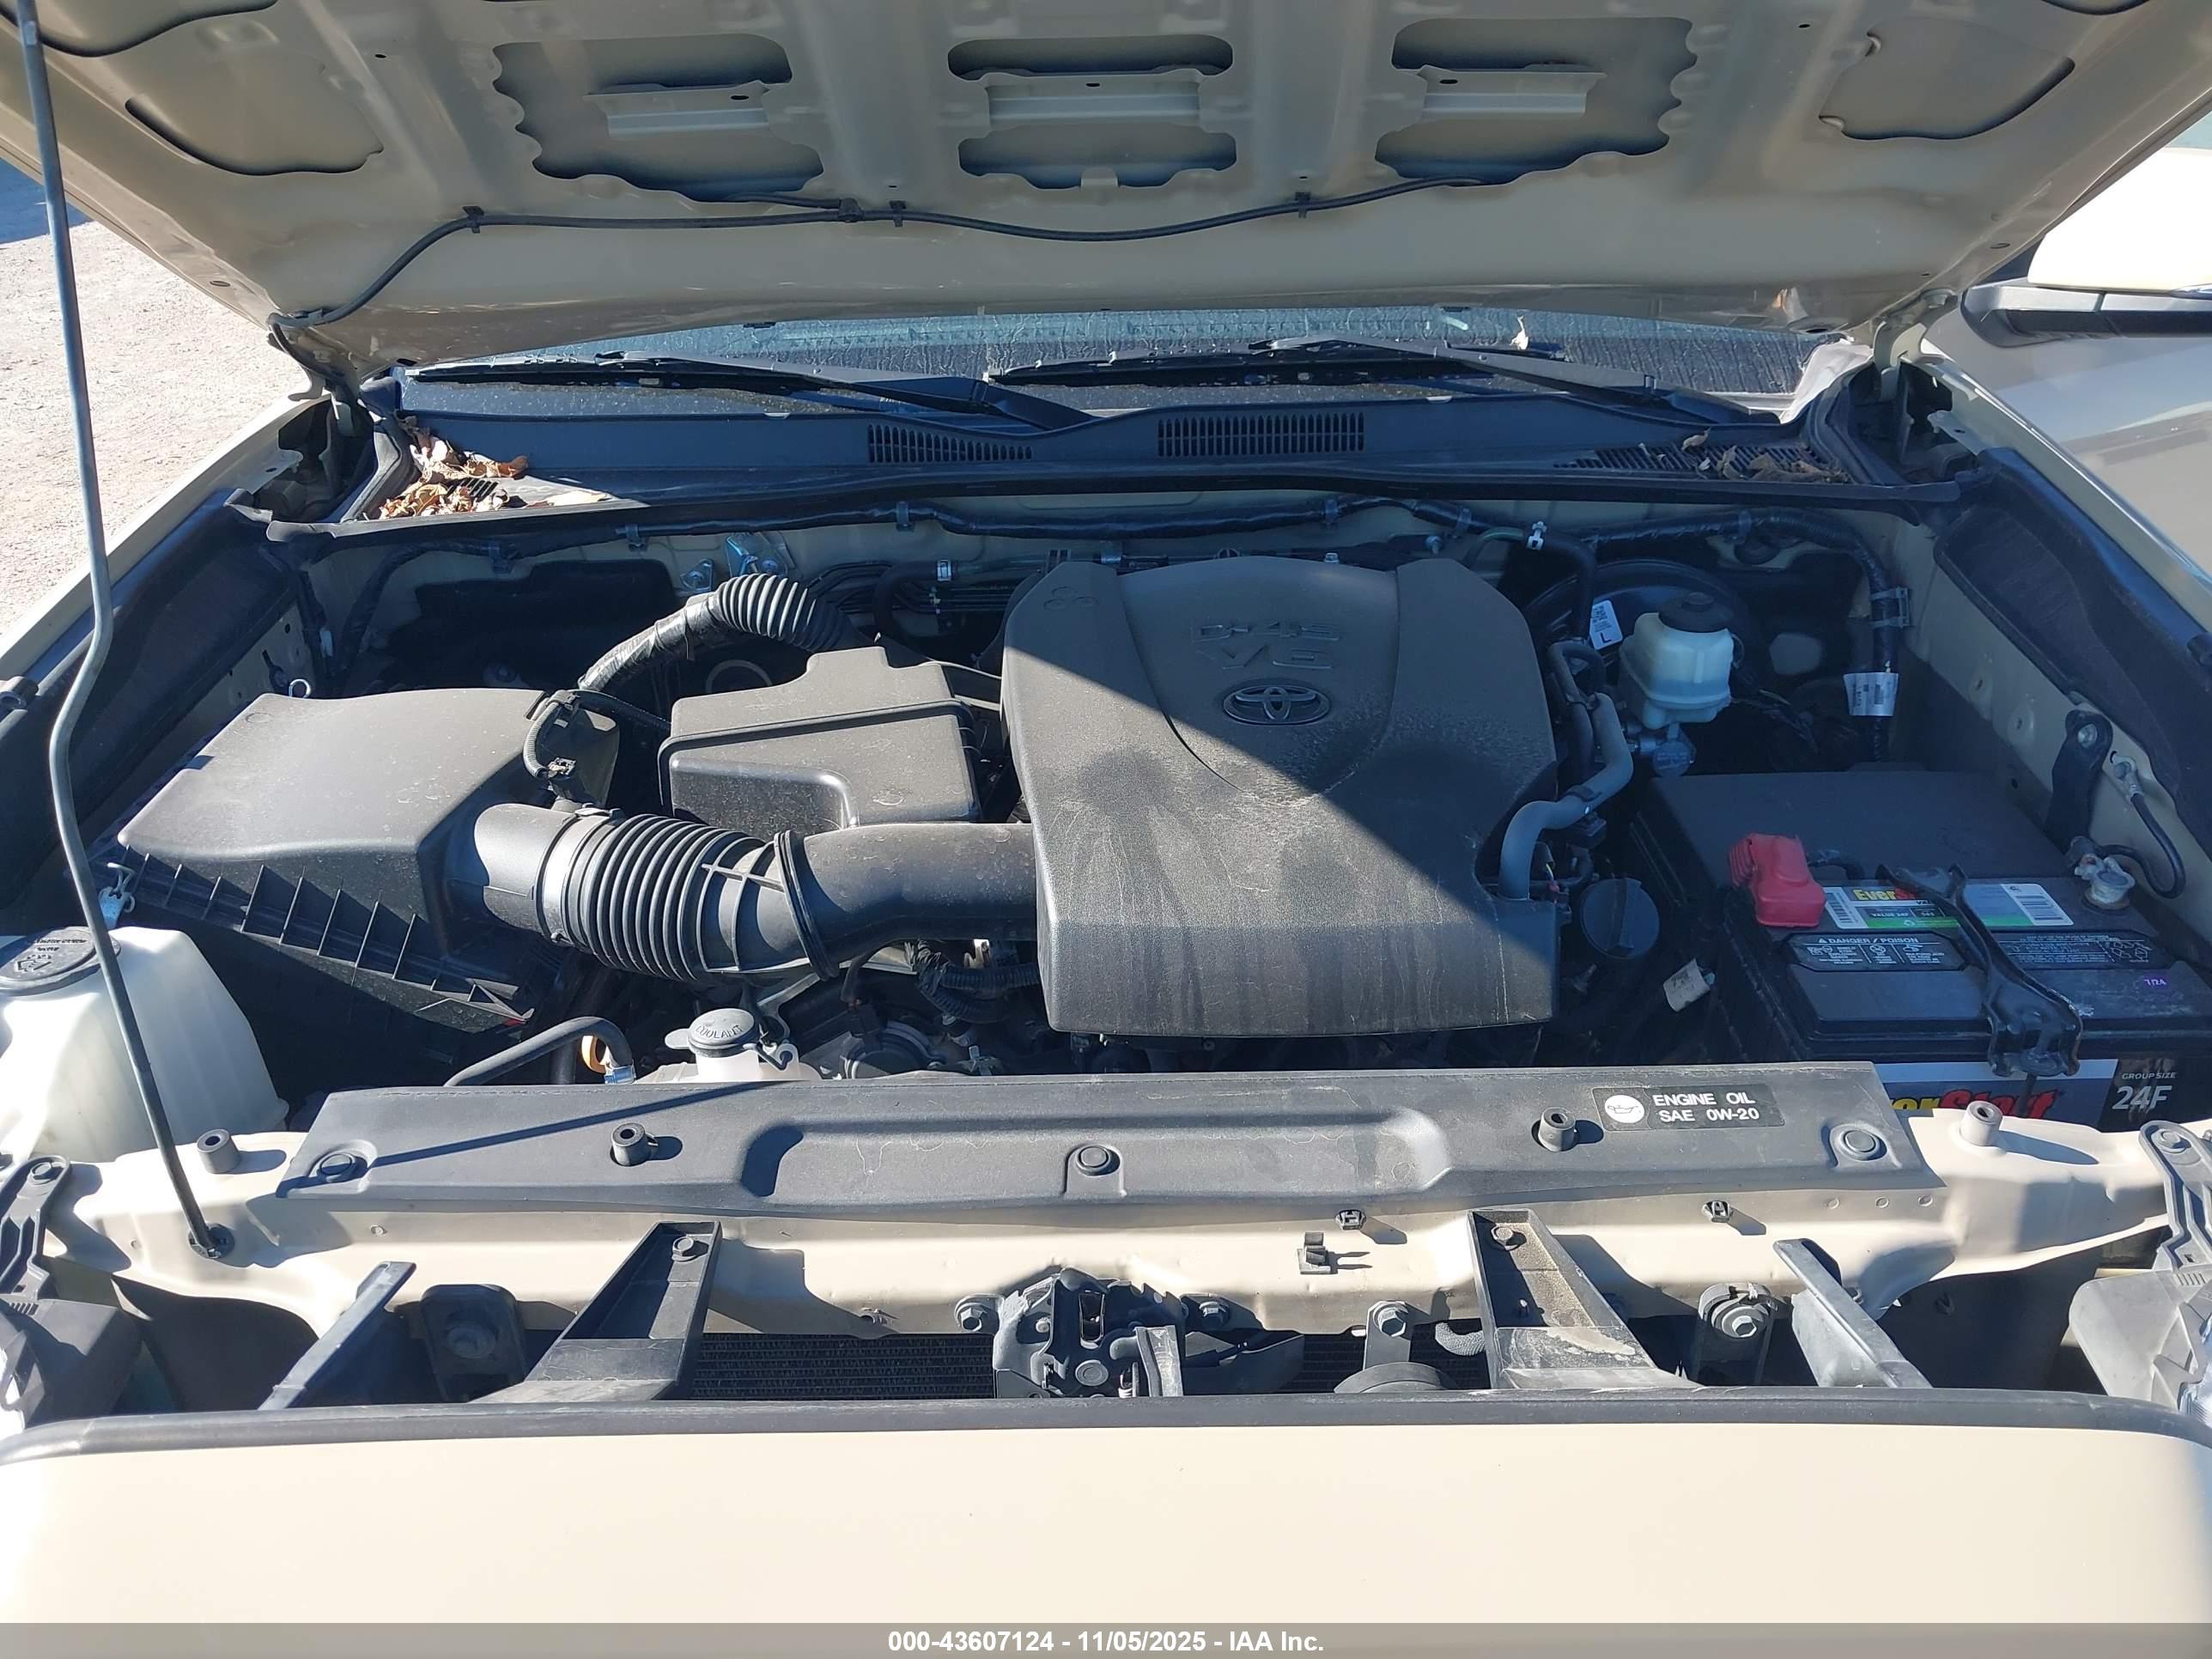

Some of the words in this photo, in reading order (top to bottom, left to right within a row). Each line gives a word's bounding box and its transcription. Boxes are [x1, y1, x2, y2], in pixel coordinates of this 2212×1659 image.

[1600, 632, 1612, 644] L
[696, 1024, 744, 1038] COOLANT
[1652, 1093, 1717, 1107] ENGINE
[1726, 1091, 1755, 1105] OIL
[2112, 1085, 2172, 1110] 24F
[1659, 1109, 1695, 1122] SAE
[1706, 1108, 1759, 1121] 0W-20
